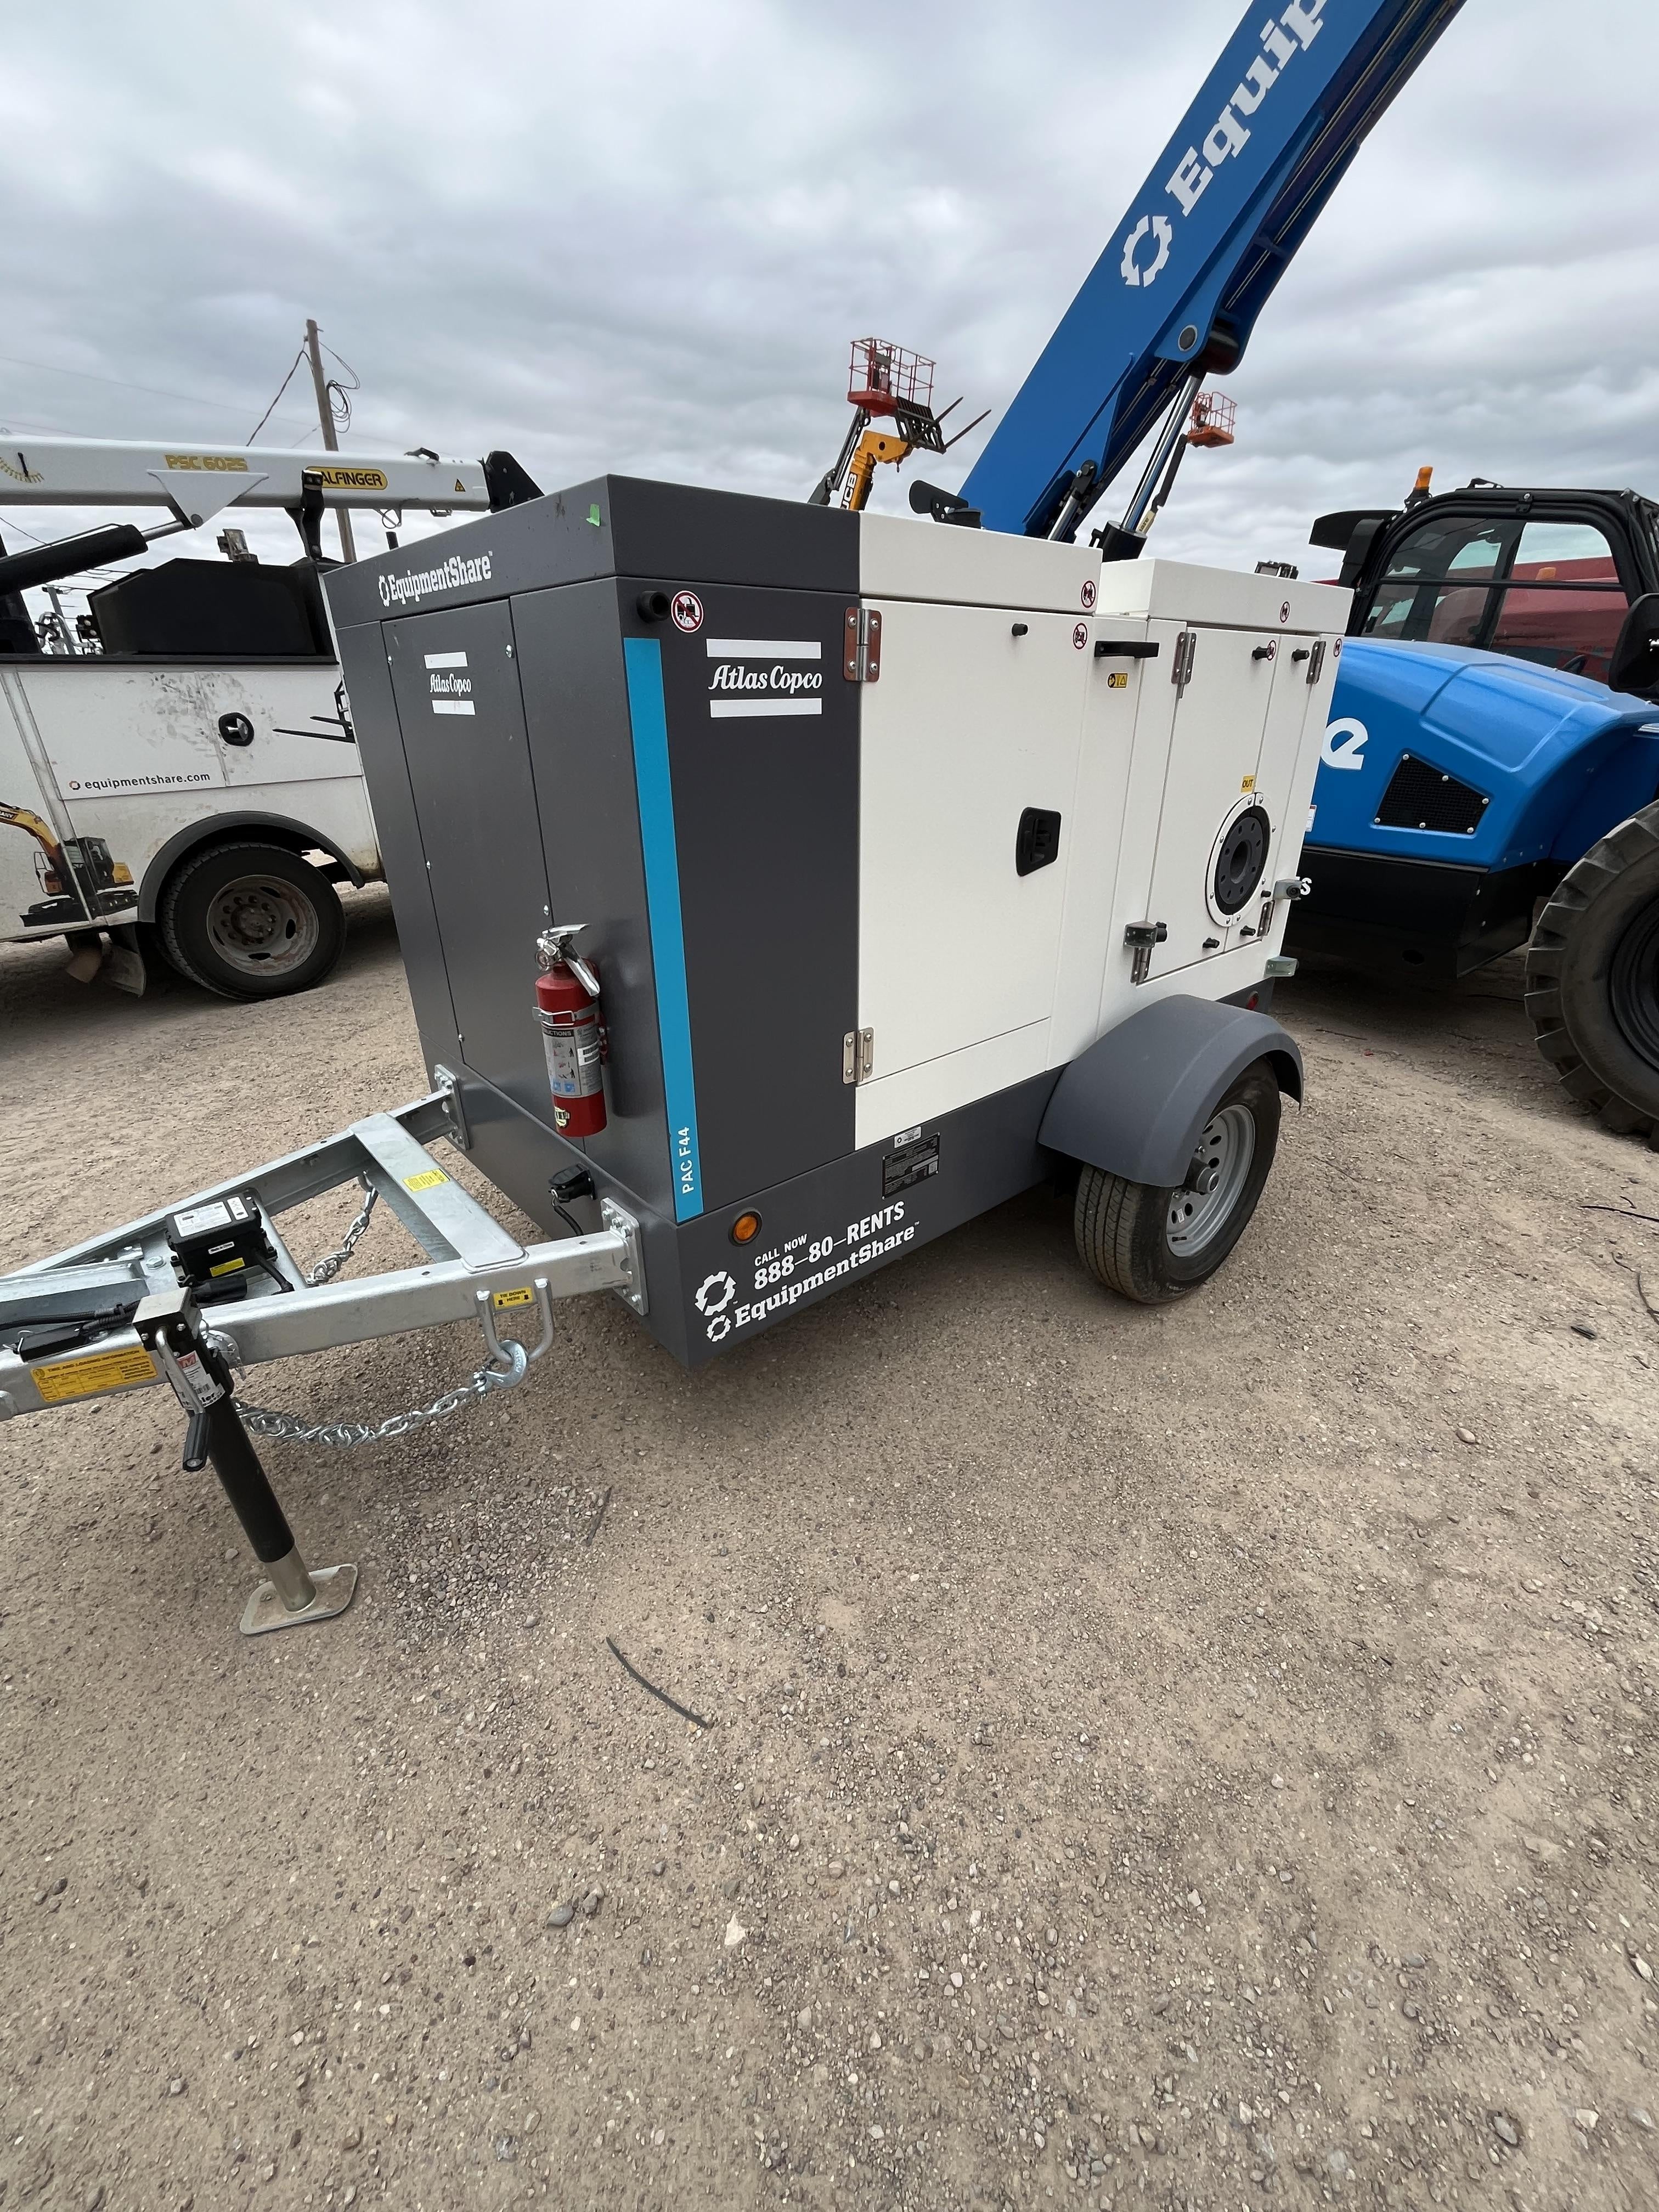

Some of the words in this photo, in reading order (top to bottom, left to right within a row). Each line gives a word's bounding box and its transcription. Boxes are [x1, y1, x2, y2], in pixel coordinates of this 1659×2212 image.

[165, 455, 201, 470] PSC
[203, 457, 248, 471] 6025
[321, 471, 383, 487] ALFINGER
[387, 555, 492, 605] EquipmentShare
[708, 664, 768, 690] Atlas
[770, 665, 822, 694] Copco
[84, 773, 211, 790] equipmentshare.com
[1242, 779, 1254, 788] OUT
[678, 1127, 691, 1157] F44
[680, 1160, 694, 1194] PAC
[754, 1249, 780, 1267] CALL
[784, 1233, 808, 1253] NOW
[735, 1225, 915, 1328] EquipmentShare
